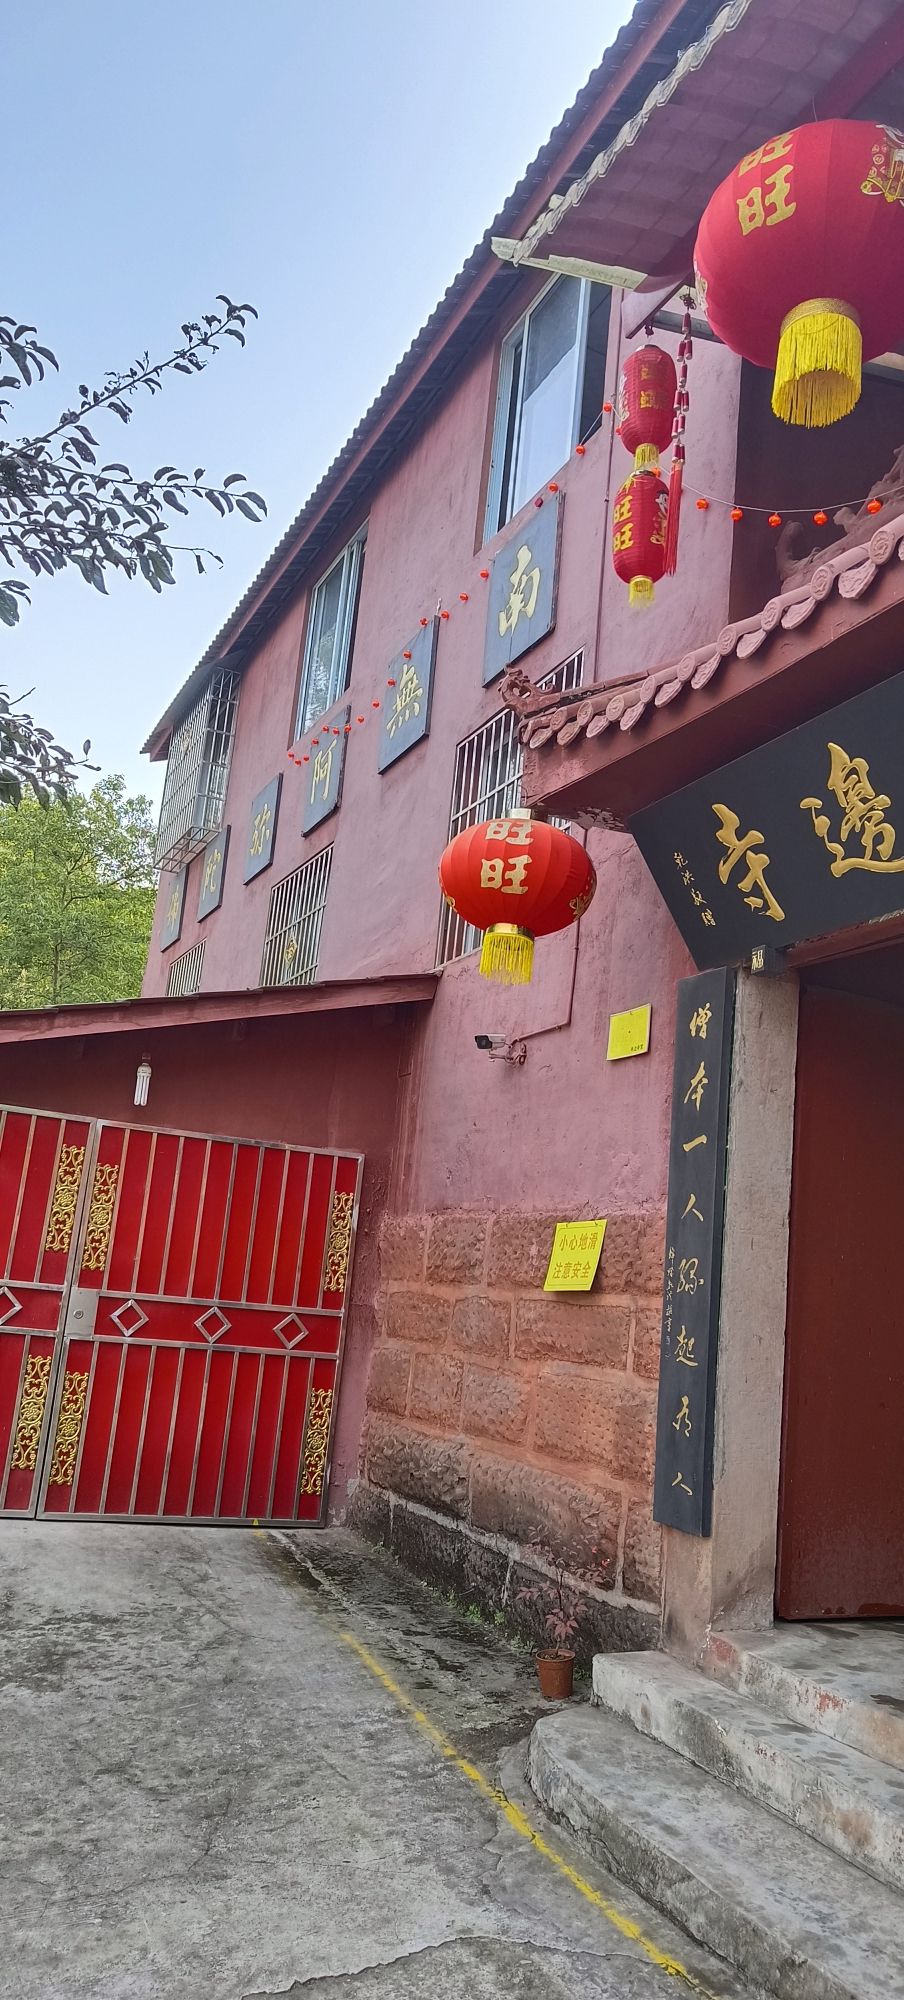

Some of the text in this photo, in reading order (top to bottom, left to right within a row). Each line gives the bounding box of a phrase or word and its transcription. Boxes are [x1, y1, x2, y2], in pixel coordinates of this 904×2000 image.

[499, 544, 541, 637] 南
[386, 663, 424, 740] 無
[310, 739, 337, 806] 阿
[480, 821, 534, 895] 旺旺
[551, 1260, 592, 1279] 注意安全
[559, 1231, 599, 1252] 小心地滑
